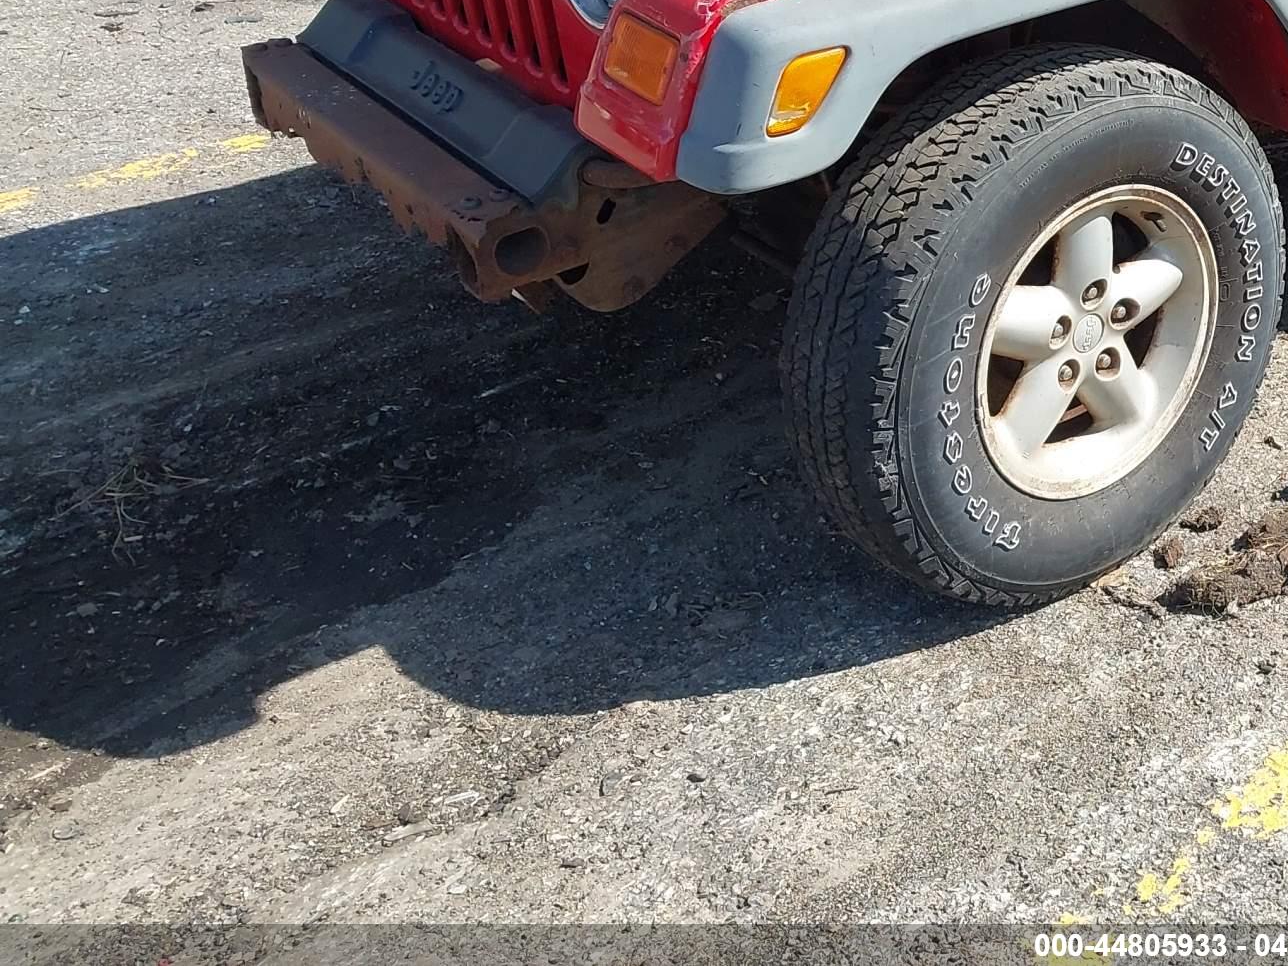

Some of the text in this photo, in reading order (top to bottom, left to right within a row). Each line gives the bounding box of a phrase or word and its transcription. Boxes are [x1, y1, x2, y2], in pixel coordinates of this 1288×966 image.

[408, 59, 465, 113] Jeep
[1174, 141, 1263, 364] DESTINATION
[939, 273, 1022, 550] Firestone
[1198, 381, 1238, 452] A/T
